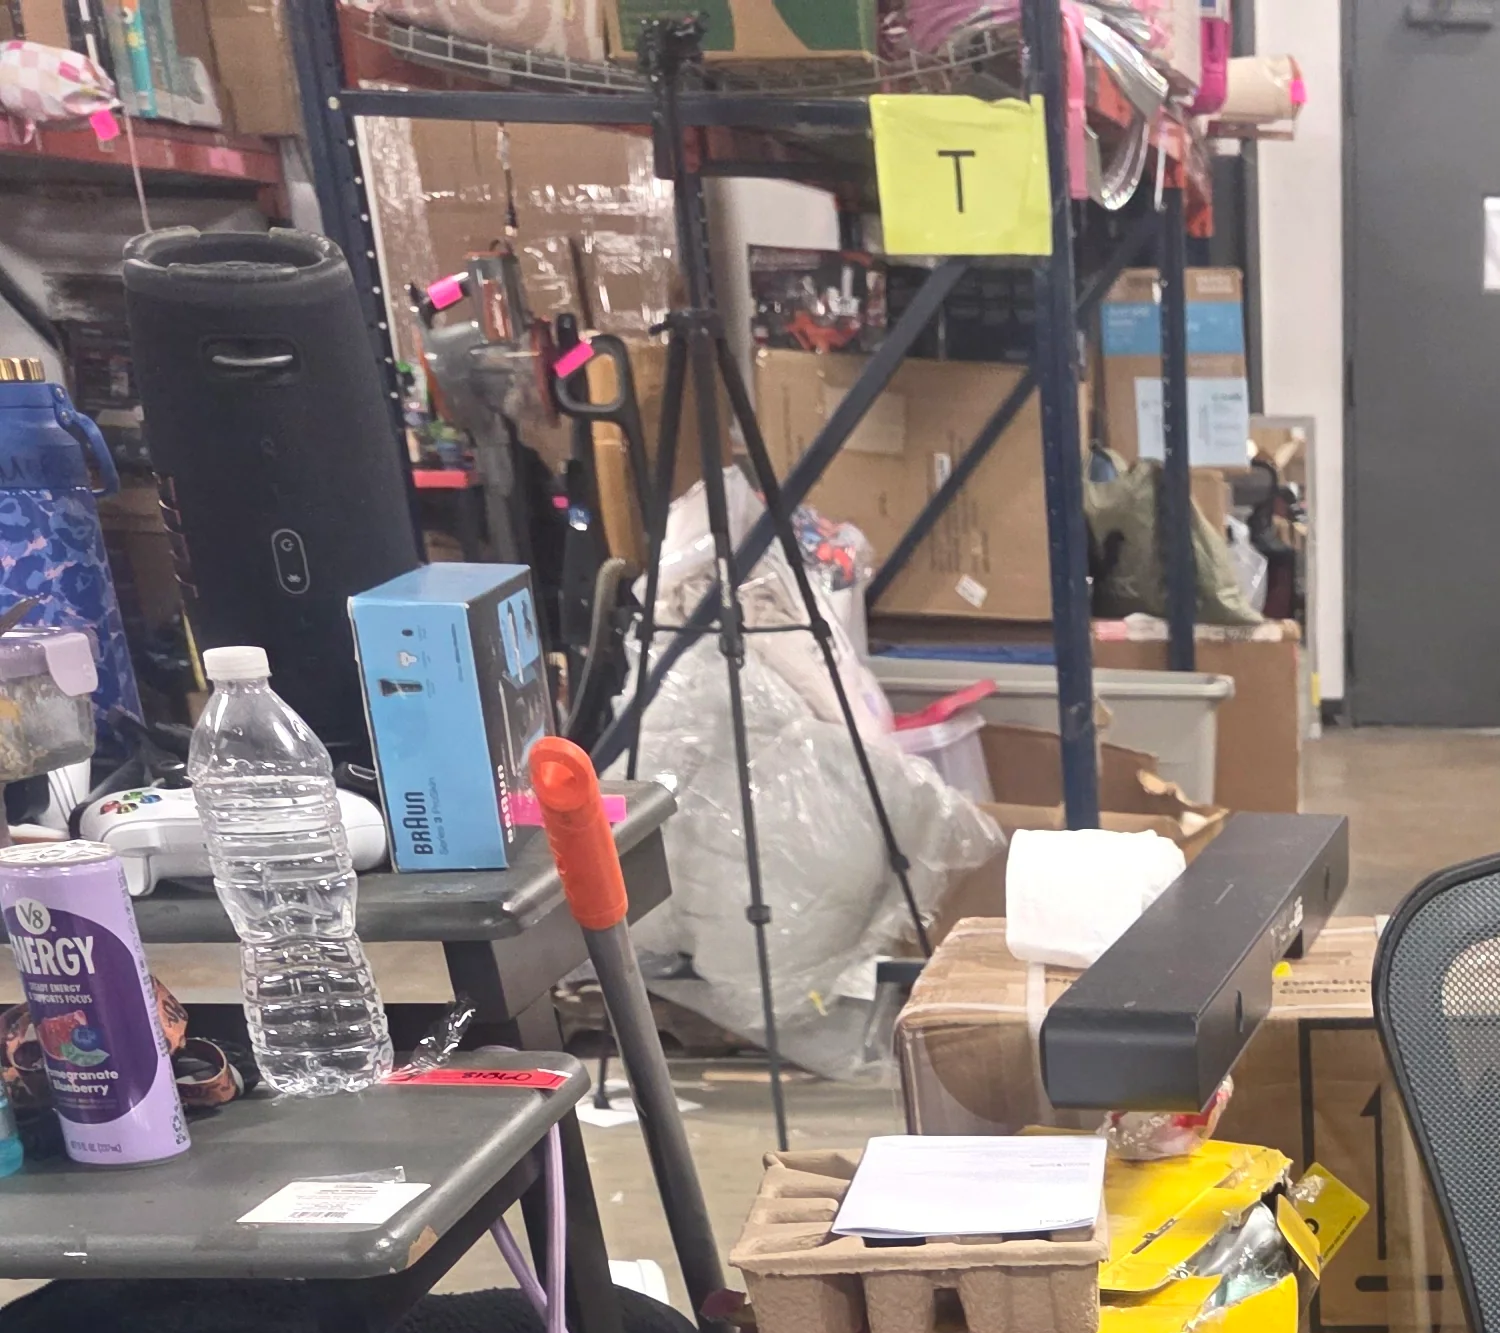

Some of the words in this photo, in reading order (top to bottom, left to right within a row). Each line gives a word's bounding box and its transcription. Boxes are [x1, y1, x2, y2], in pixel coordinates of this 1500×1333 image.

[937, 150, 976, 215] T
[403, 791, 434, 855] BRAUN
[19, 902, 44, 930] V8
[49, 983, 81, 993] ENERGY
[64, 994, 93, 1004] FOCUS
